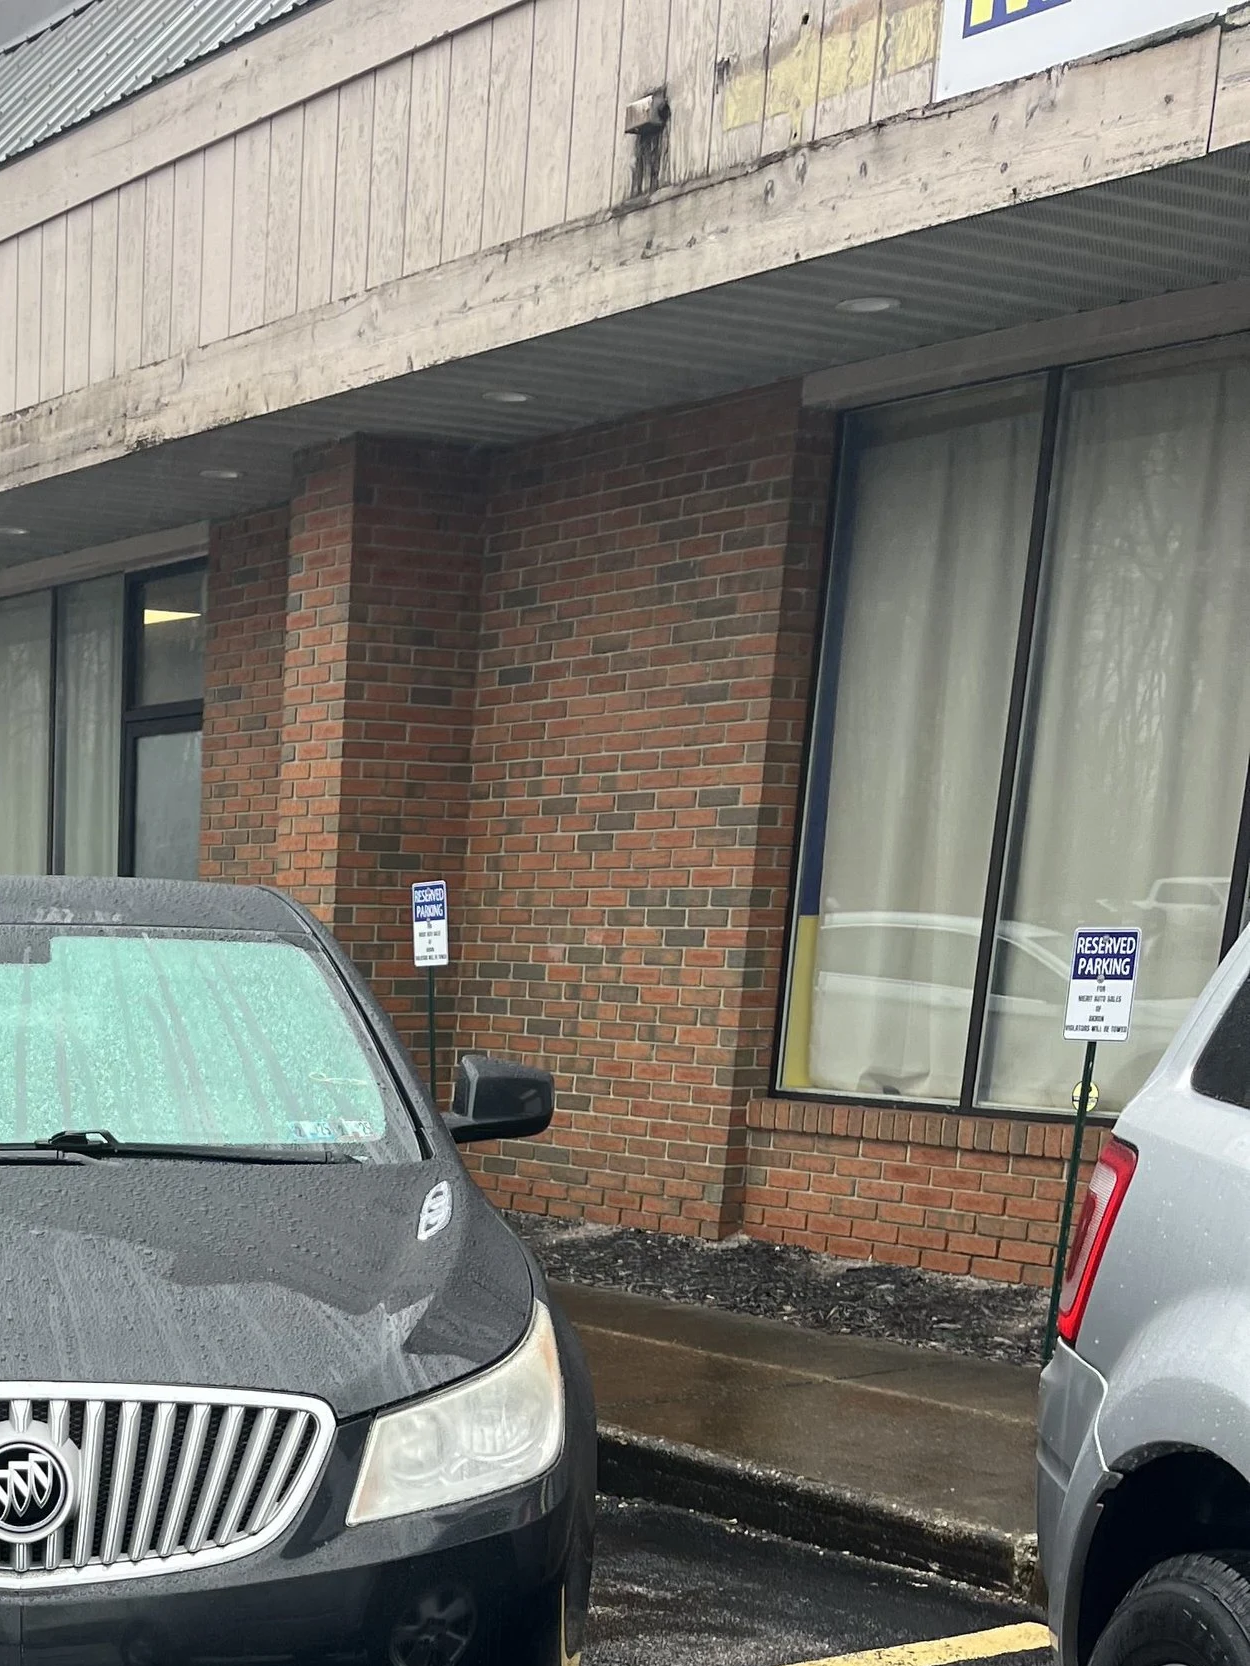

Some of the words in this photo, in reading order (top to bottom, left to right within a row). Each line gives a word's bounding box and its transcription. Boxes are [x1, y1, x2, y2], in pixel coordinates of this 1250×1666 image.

[414, 887, 444, 903] RESERVED
[416, 903, 443, 919] PARKING
[1076, 936, 1136, 955] RESERVED
[1077, 957, 1131, 976] PARKING
